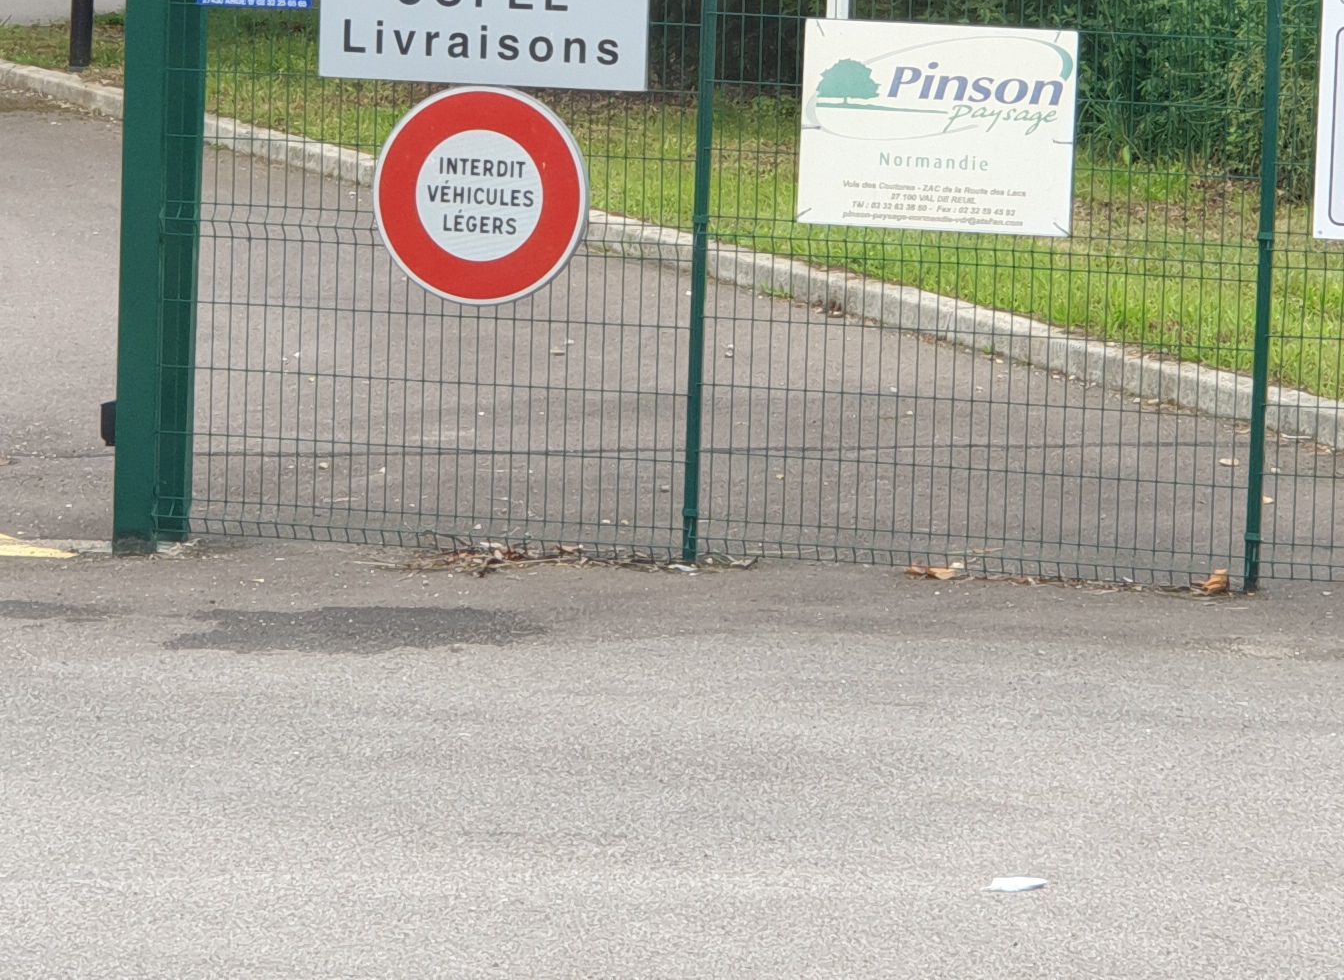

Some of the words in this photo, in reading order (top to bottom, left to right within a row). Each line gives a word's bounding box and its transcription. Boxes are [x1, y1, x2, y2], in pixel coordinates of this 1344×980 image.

[342, 18, 620, 66] Livraisons
[886, 61, 1064, 106] Pinson
[943, 103, 1058, 136] paysage
[439, 156, 526, 180] INTERDIT
[879, 152, 989, 172] Normandie
[427, 181, 535, 208] VÉHICULES
[891, 192, 901, 200] 27
[919, 194, 935, 202] VAL
[937, 195, 949, 203] DE
[951, 195, 977, 204] REUIL
[922, 184, 941, 193] ZAC
[942, 185, 953, 193] de
[936, 205, 951, 213] Fax
[442, 209, 517, 236] LÉGERS
